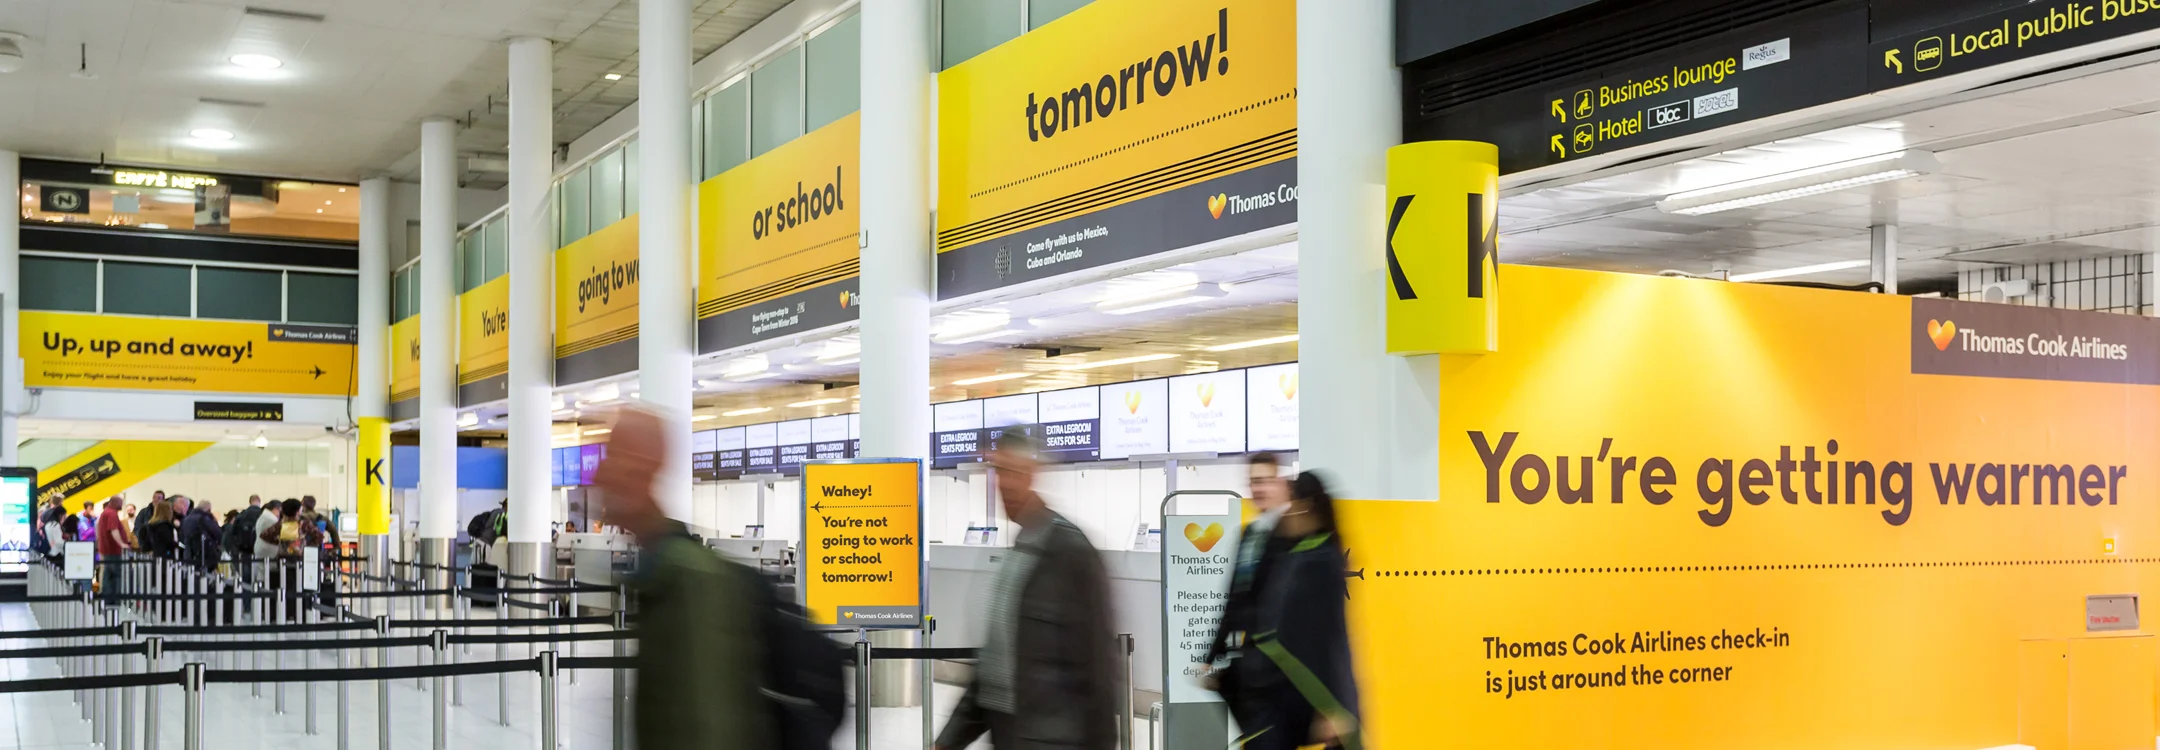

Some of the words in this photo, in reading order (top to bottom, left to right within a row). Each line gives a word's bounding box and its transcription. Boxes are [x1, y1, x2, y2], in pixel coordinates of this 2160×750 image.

[1951, 19, 2009, 56] Local
[2017, 3, 2094, 47] public
[1749, 48, 1776, 61] Regus
[1026, 8, 1228, 142] tomorrow!
[1600, 75, 1668, 107] Business
[1674, 57, 1736, 88] lounge
[1656, 107, 1680, 124] bloc
[1599, 110, 1642, 141] Hotel
[753, 206, 772, 240] or
[776, 165, 844, 232] school
[1228, 192, 1276, 214] Thomas
[1027, 242, 1044, 253] Come
[1045, 238, 1053, 251] fly
[1054, 234, 1068, 247] with
[1068, 234, 1076, 243] us
[1076, 232, 1083, 241] to
[1084, 225, 1108, 240] Mexico,
[1027, 257, 1043, 269] Cuba
[1044, 252, 1056, 266] and
[1056, 247, 1083, 262] Orlando
[578, 266, 610, 314] going
[612, 260, 624, 290] to
[482, 306, 506, 338] You're
[285, 330, 308, 339] Thomas
[309, 331, 323, 339] Cook
[42, 331, 84, 357] Up,
[90, 338, 121, 358] up
[127, 337, 174, 356] and
[180, 341, 253, 364] away!
[1959, 328, 2024, 354] Thomas
[2027, 333, 2068, 357] Cook
[2070, 336, 2127, 360] Airlines
[43, 371, 64, 379] Enjoy
[84, 372, 104, 380] flight
[170, 375, 197, 384] holiday
[1046, 425, 1064, 435] EXTRA
[1064, 423, 1091, 433] LEGROOM
[941, 434, 955, 443] EXTRA
[955, 432, 977, 441] LEGROOM
[1047, 437, 1064, 446] SEATS
[1065, 436, 1076, 445] FOR
[1077, 435, 1090, 444] SALE
[782, 447, 791, 455] EXTRA
[792, 446, 807, 454] LEGROOM
[816, 444, 826, 452] EXTRA
[827, 443, 844, 451] LEGROOM
[941, 444, 955, 453] SEATS
[955, 444, 965, 452] FOR
[965, 443, 976, 452] SALE
[366, 458, 385, 485] K
[1466, 430, 1676, 505] You're
[1696, 439, 1913, 527] getting
[1930, 462, 2127, 506] warmer
[822, 485, 872, 500] Wahey!
[822, 516, 863, 528] You're
[866, 517, 888, 527] not
[822, 534, 860, 549] going
[863, 535, 876, 545] to
[880, 534, 913, 545] work
[822, 556, 836, 564] or
[839, 553, 882, 564] school
[1171, 555, 1210, 564] Thomas
[822, 571, 893, 582] tomorrow!
[1186, 566, 1224, 575] Airlines
[1178, 591, 1208, 599] Please
[1210, 590, 1221, 599] be
[1174, 604, 1189, 612] the
[1188, 617, 1209, 627] gate
[1183, 629, 1205, 637] later
[1208, 629, 1218, 637] th
[1180, 642, 1191, 650] 45
[1482, 636, 1567, 659] Thomas
[1573, 632, 1626, 655] Cook
[1630, 630, 1706, 653] Airlines
[1711, 626, 1789, 649] check-in
[1486, 670, 1503, 693] is
[1505, 669, 1547, 699] just
[1551, 665, 1626, 690] around
[1631, 664, 1664, 685] the
[1669, 664, 1733, 683] corner
